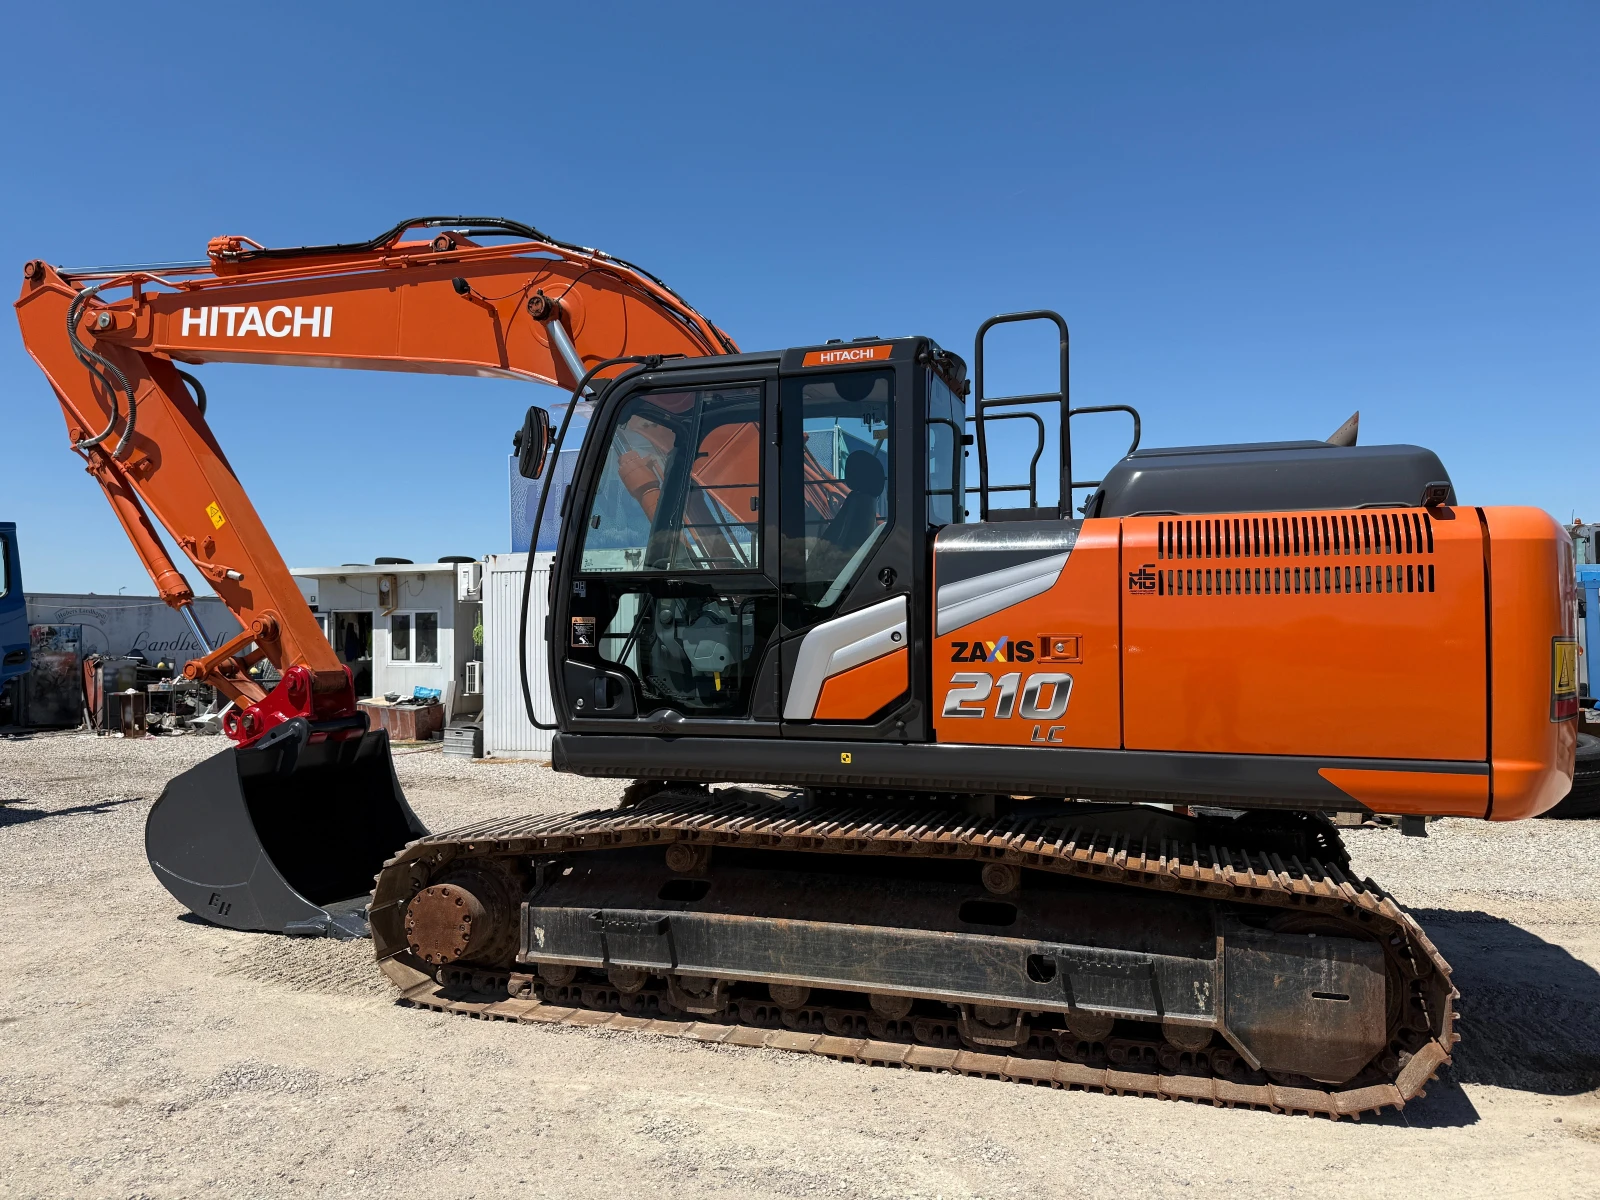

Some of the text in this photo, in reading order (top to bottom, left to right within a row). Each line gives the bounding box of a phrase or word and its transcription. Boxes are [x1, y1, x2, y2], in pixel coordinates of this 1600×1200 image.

[181, 305, 333, 338] HITACHI
[820, 348, 874, 363] HITACHI
[131, 630, 229, 652] Landhedl
[950, 635, 1035, 663] ZAXIS
[941, 671, 1074, 720] 210
[1030, 724, 1066, 743] LC
